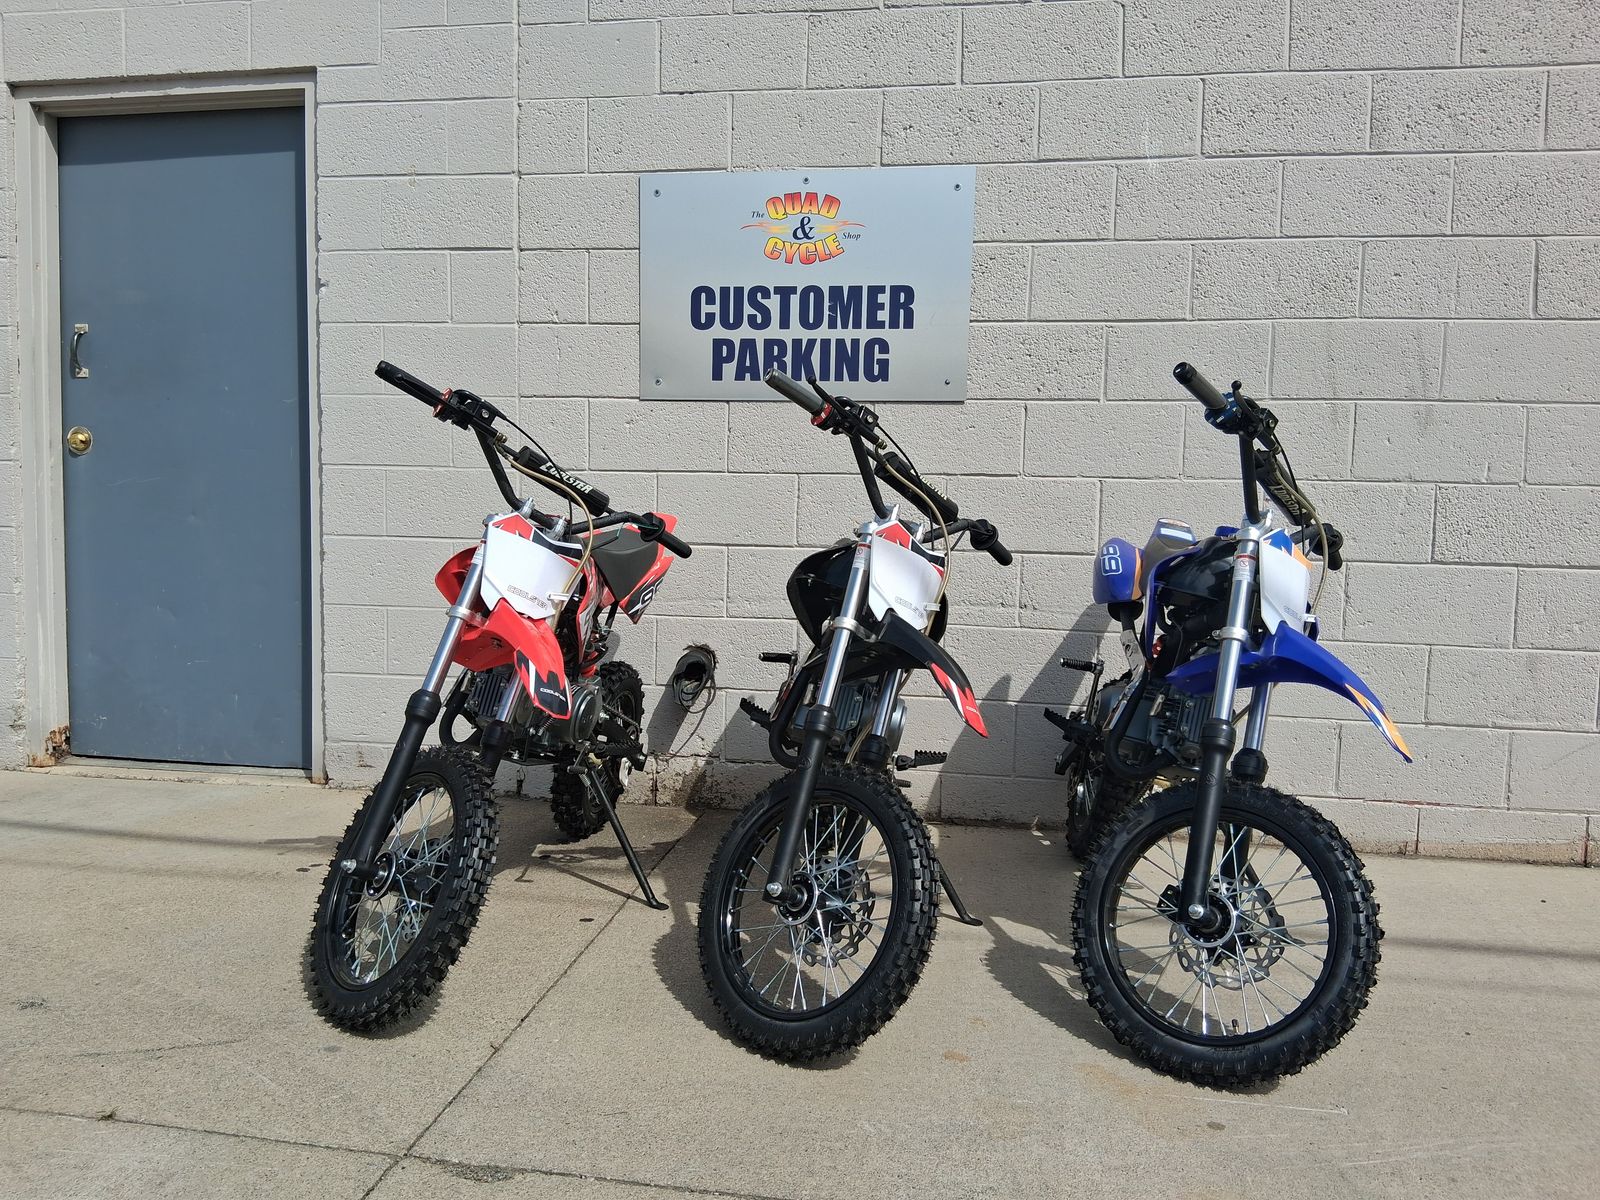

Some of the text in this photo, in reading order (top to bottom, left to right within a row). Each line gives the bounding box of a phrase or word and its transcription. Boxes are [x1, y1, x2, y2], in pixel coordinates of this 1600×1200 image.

[751, 192, 842, 221] The QUAD
[792, 216, 816, 241] &
[763, 231, 861, 265] CYCLE Shop
[690, 284, 916, 331] CUSTOMER
[711, 337, 890, 383] PARKING
